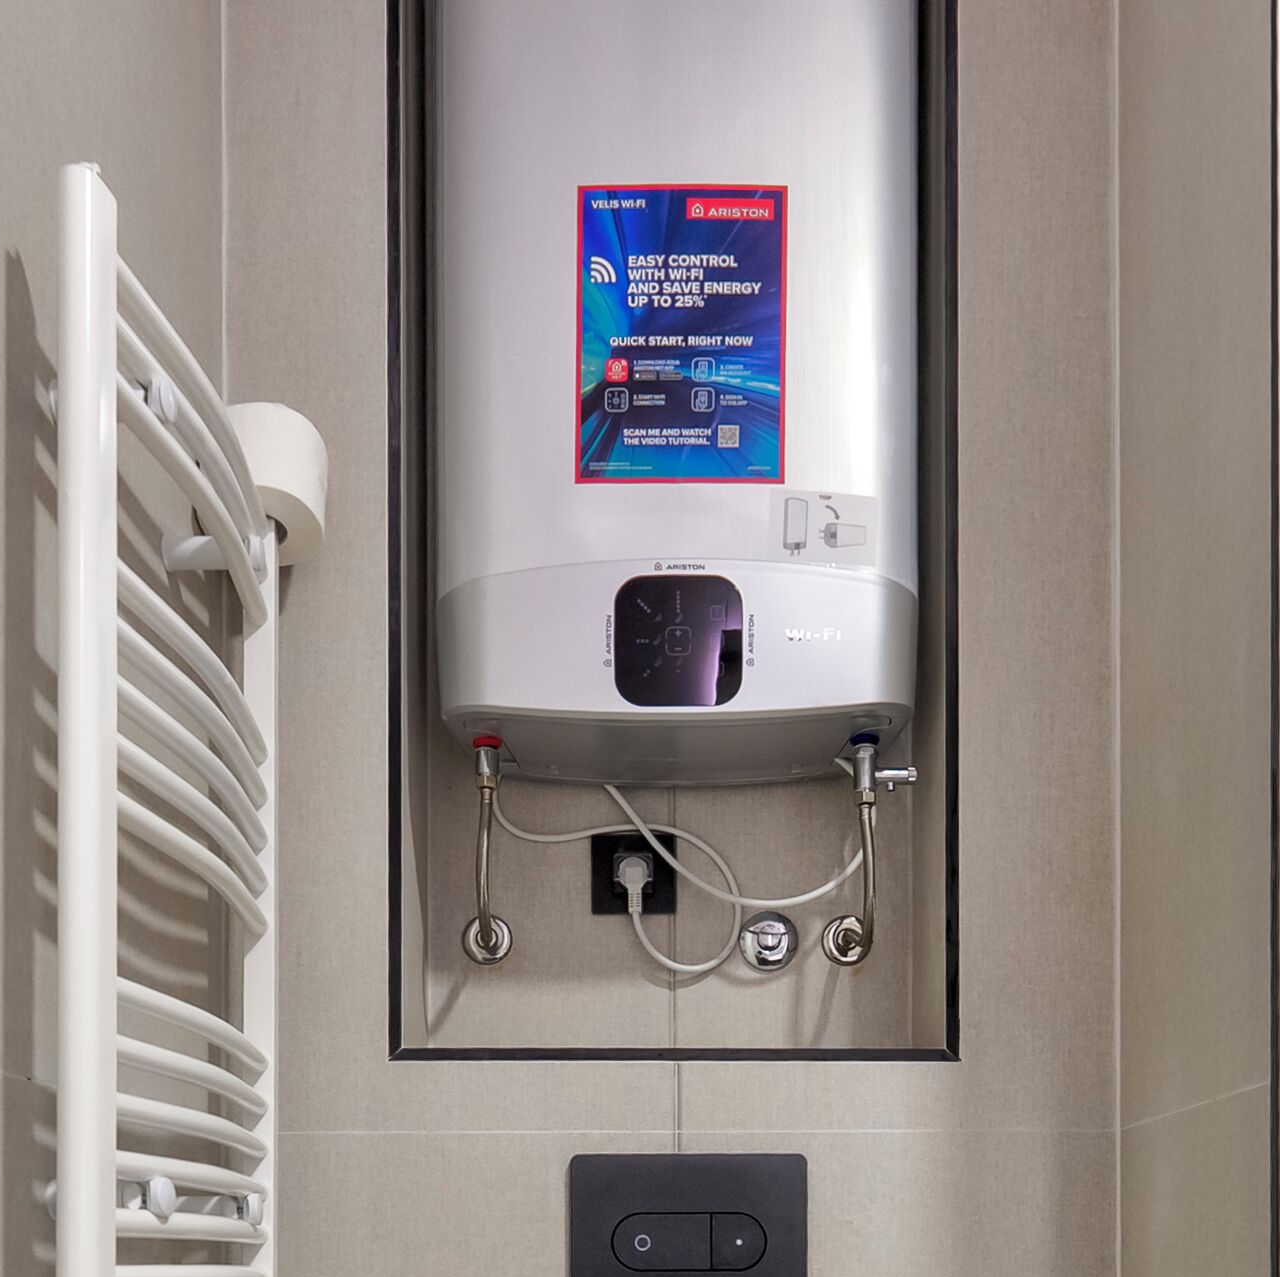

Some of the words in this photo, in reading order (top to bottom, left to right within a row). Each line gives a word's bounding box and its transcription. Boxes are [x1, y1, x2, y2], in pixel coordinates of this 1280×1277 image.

[591, 199, 619, 209] VELIS
[708, 208, 769, 217] ARISTON
[628, 255, 665, 267] EASY
[668, 255, 738, 267] CONTROL
[628, 268, 665, 281] WITH
[627, 282, 659, 294] AND
[662, 282, 700, 294] SAVE
[703, 282, 762, 294] ENERGY
[627, 295, 649, 308] UP
[651, 295, 672, 308] TO
[610, 336, 646, 347] QUICK
[648, 336, 686, 348] START,
[687, 336, 723, 347] RIGHT
[724, 336, 754, 347] NOW
[623, 428, 647, 436] SCAN
[648, 428, 661, 436] ME
[661, 428, 681, 436] AND
[681, 428, 712, 436] WATCH
[624, 437, 640, 446] THE
[640, 437, 668, 446] VIDEO
[668, 437, 711, 446] TUTORIAL.
[666, 563, 706, 571] ARISTON
